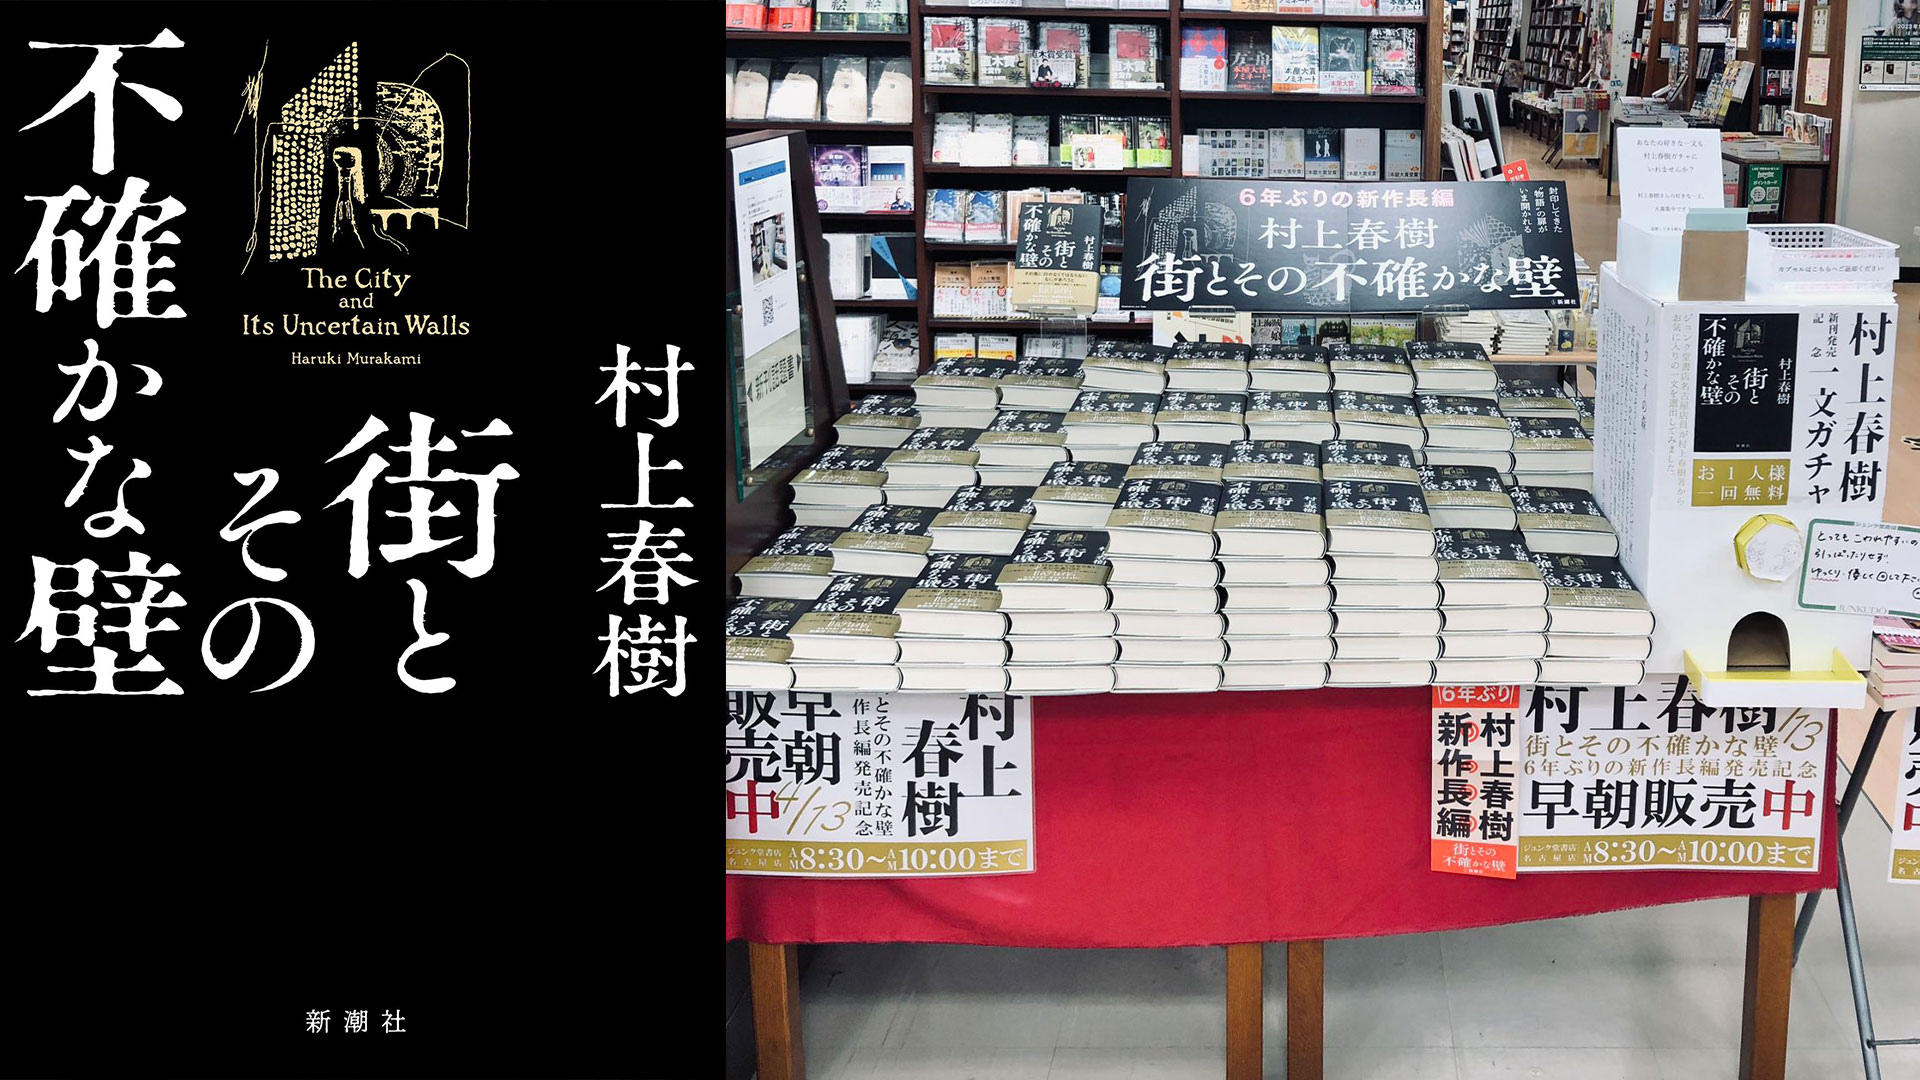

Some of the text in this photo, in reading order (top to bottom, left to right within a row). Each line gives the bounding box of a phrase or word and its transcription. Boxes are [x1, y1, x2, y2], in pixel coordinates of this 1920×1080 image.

[1643, 152, 1698, 160] 村上春樹ガチャに
[1239, 188, 1454, 208] 6年ぶりの新作長編
[1519, 187, 1532, 233] いま開かれる
[1548, 186, 1563, 233] 封印してきた
[1020, 204, 1043, 268] 不確かな壁
[1257, 217, 1439, 250] 村上春樹
[1039, 245, 1053, 267] その
[1054, 240, 1076, 269] 街と
[1082, 235, 1096, 270] 村上春樹
[301, 268, 411, 298] The City
[1135, 252, 1565, 302] 街とその不確かな壁
[339, 293, 373, 309] and
[243, 314, 469, 335] Its Uncertain Walls
[1811, 313, 1824, 358] 記念
[1826, 313, 1839, 358] 新刊発売
[14, 28, 187, 696] 不確かな壁
[292, 352, 420, 365] Haruki Murakami
[1700, 317, 1727, 406] 不確かな壁
[1724, 374, 1741, 404] その
[1742, 367, 1769, 405] 街と
[1776, 357, 1793, 405] 村上春樹
[1839, 312, 1893, 503] 村上春樹
[1804, 366, 1840, 505] 一文ガチャ
[1697, 464, 1786, 482] お1人様
[1696, 485, 1785, 501] 一回無料
[593, 344, 699, 697] 村上春樹
[1817, 531, 1849, 542] とっても
[323, 412, 520, 693] 街と
[201, 468, 315, 693] その
[1811, 567, 1841, 578] ゆっくり
[1837, 604, 1888, 614] JUNKUDO
[1441, 685, 1511, 703] 6年ぶり
[781, 690, 842, 786] 早朝
[959, 694, 1024, 797] 村上
[1525, 734, 1779, 758] 街とその不確かな壁
[852, 698, 874, 837] 作長編発売記念
[873, 697, 893, 837] とその不確かな壁
[901, 720, 965, 837] 春樹
[1436, 711, 1474, 839] 新作長編
[1478, 711, 1516, 842] 村上春樹
[1524, 759, 1818, 779] 6年ぶりの新作長編発売記念
[774, 780, 852, 835] 4/13
[1523, 778, 1816, 831] 早朝販売中
[727, 846, 782, 857] ジュンク堂書店
[899, 847, 1024, 871] 10:00まで
[1452, 843, 1497, 858] 街とその
[1523, 840, 1578, 852] ジュンク堂書店
[1523, 853, 1577, 863] 名古屋店
[1689, 840, 1812, 865] 10:00まで
[728, 858, 783, 867] 名古屋店
[1443, 856, 1507, 873] 不確かな壁
[306, 1009, 406, 1033] 新潮社
